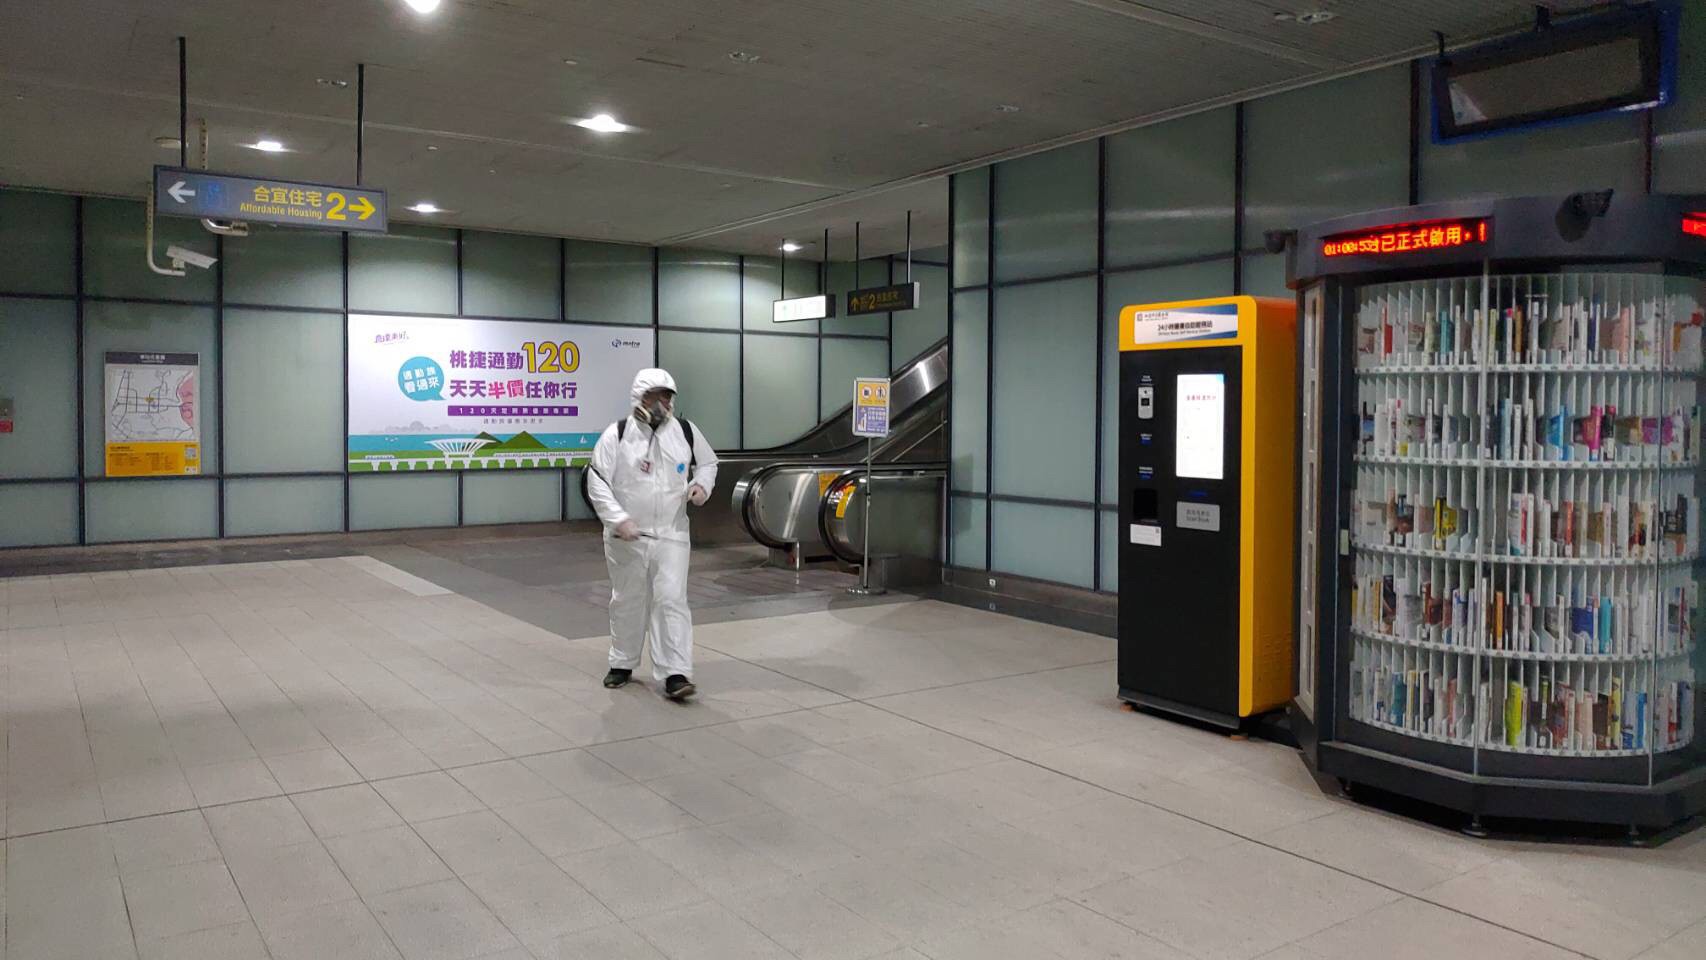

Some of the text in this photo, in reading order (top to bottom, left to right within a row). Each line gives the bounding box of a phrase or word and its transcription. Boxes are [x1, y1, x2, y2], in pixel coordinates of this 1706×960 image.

[240, 203, 322, 219] Affordable Housing
[254, 186, 347, 220] 合宜住宅 2
[449, 379, 578, 400] 天天半價任你行
